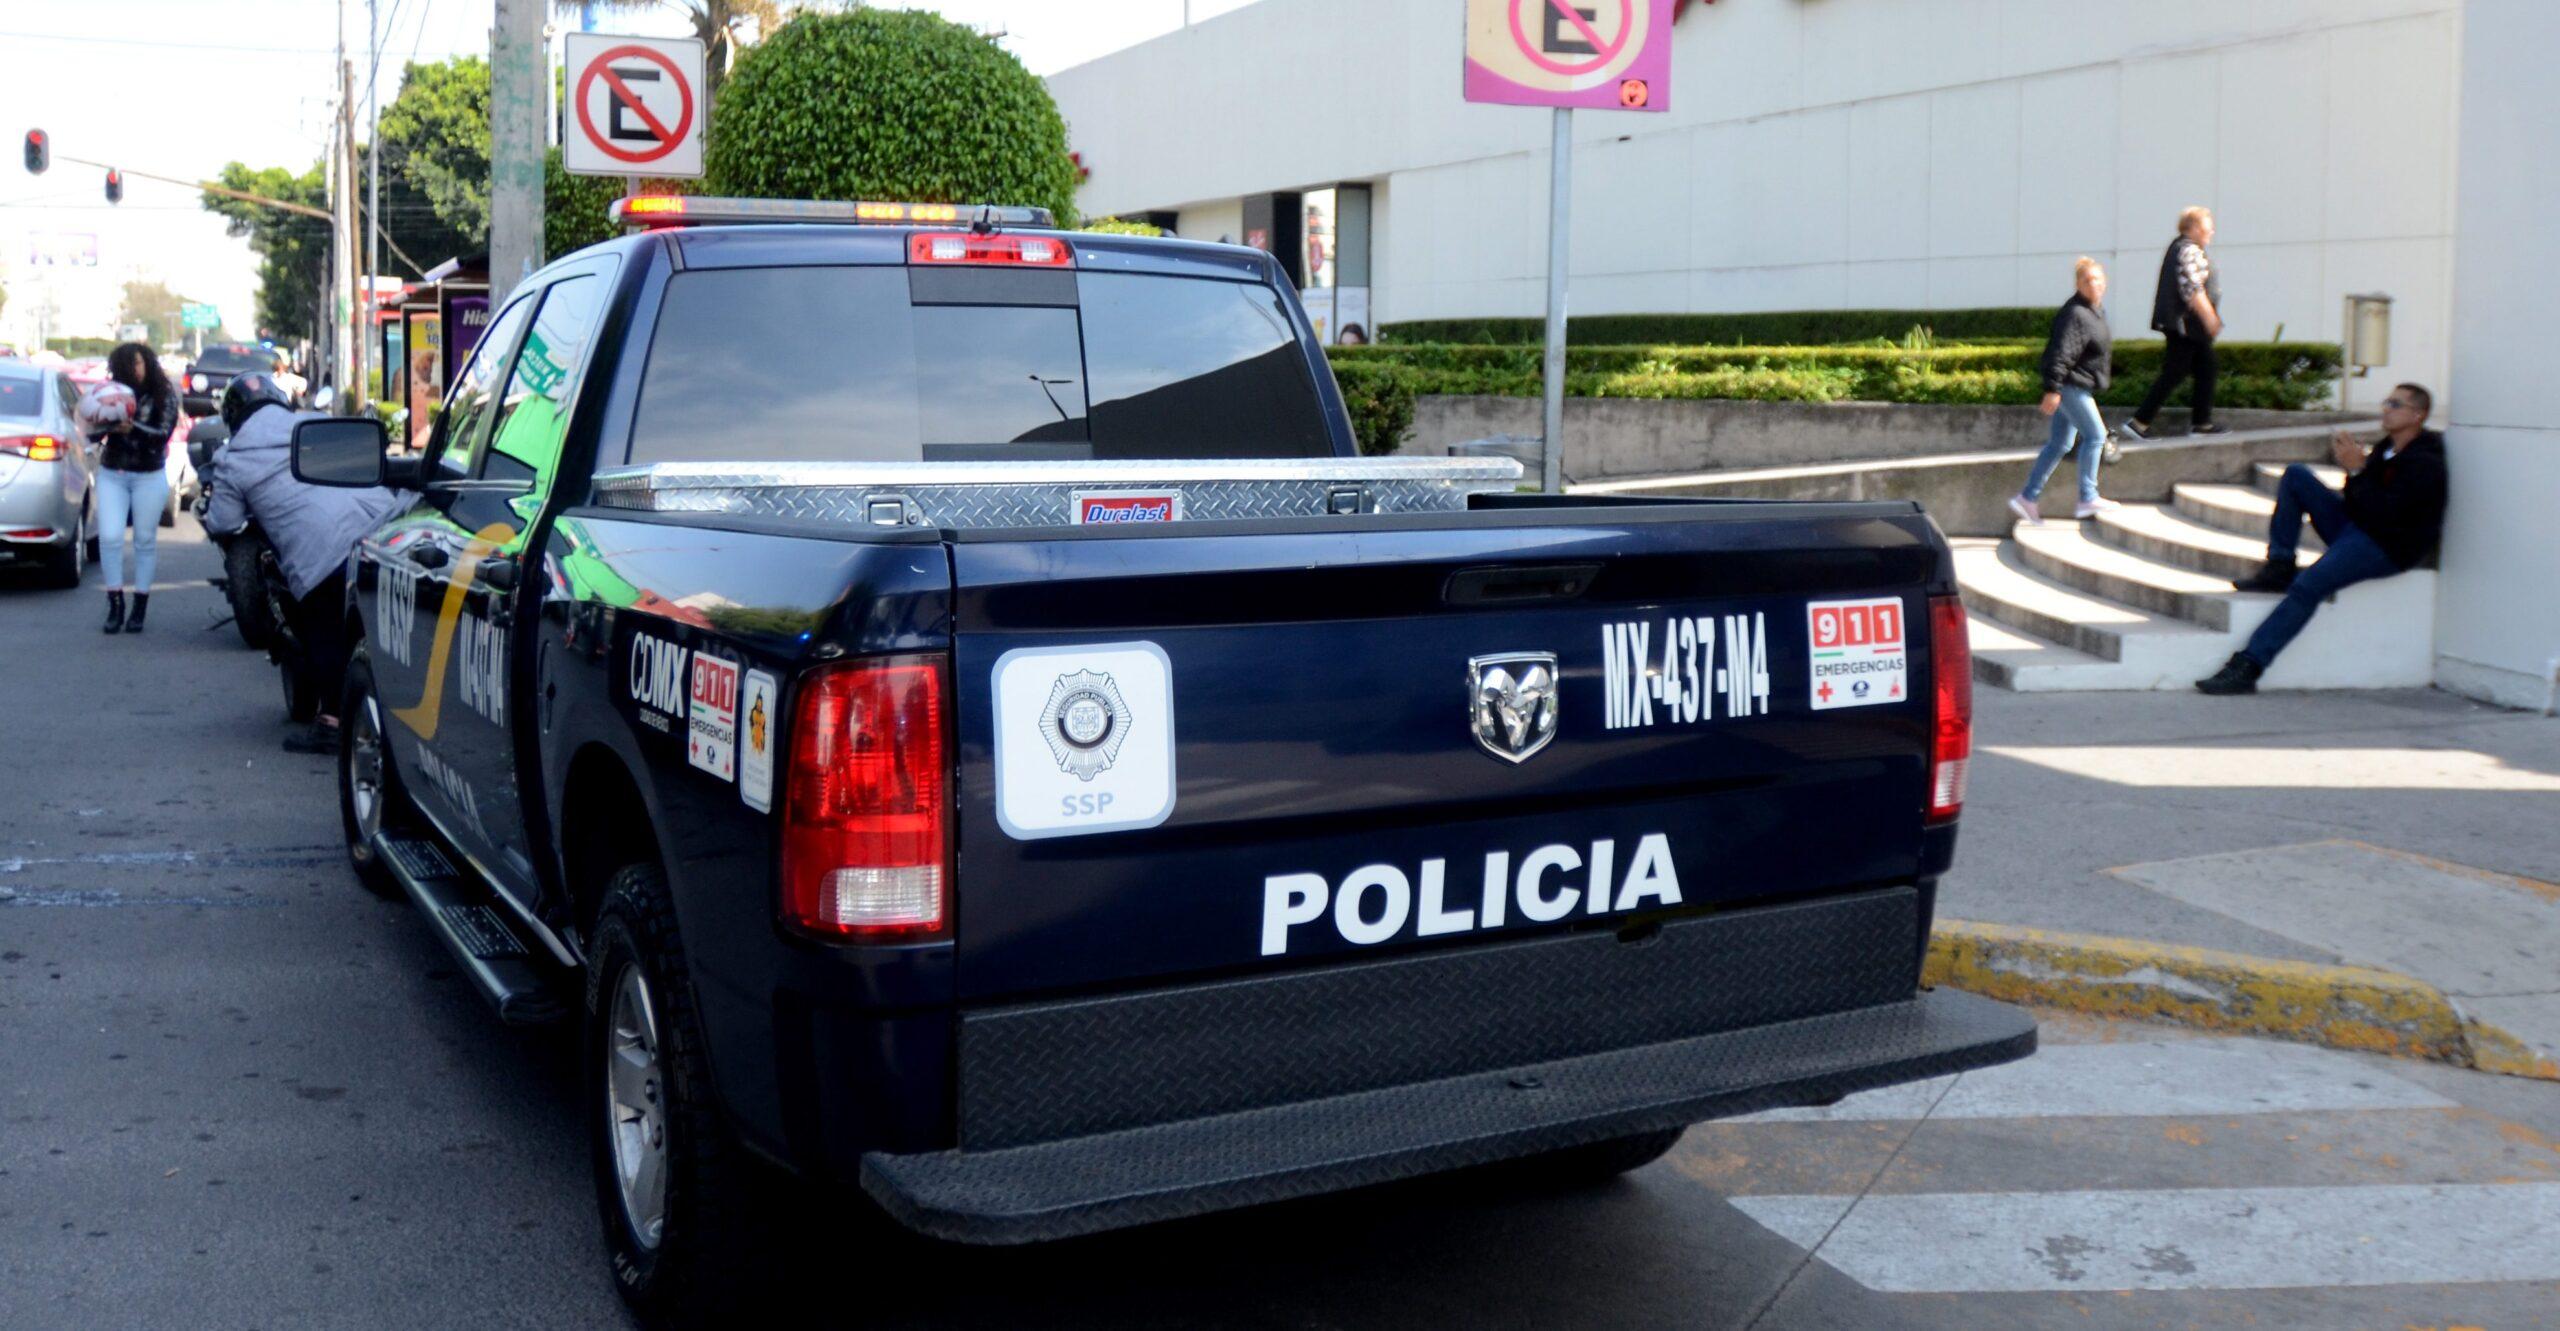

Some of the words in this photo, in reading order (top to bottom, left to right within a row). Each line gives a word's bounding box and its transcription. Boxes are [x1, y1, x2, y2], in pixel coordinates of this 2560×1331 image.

[1085, 502, 1168, 523] Duralast
[1818, 609, 1893, 643] 911
[631, 631, 688, 718] CDMX
[1602, 611, 1770, 729] MX-437-M4
[1815, 658, 1904, 677] EMERGENCIAS
[693, 664, 731, 711] 911
[690, 716, 733, 745] EMERGENCIAS
[1061, 792, 1114, 817] SSP
[1261, 832, 1683, 957] POLICIA
